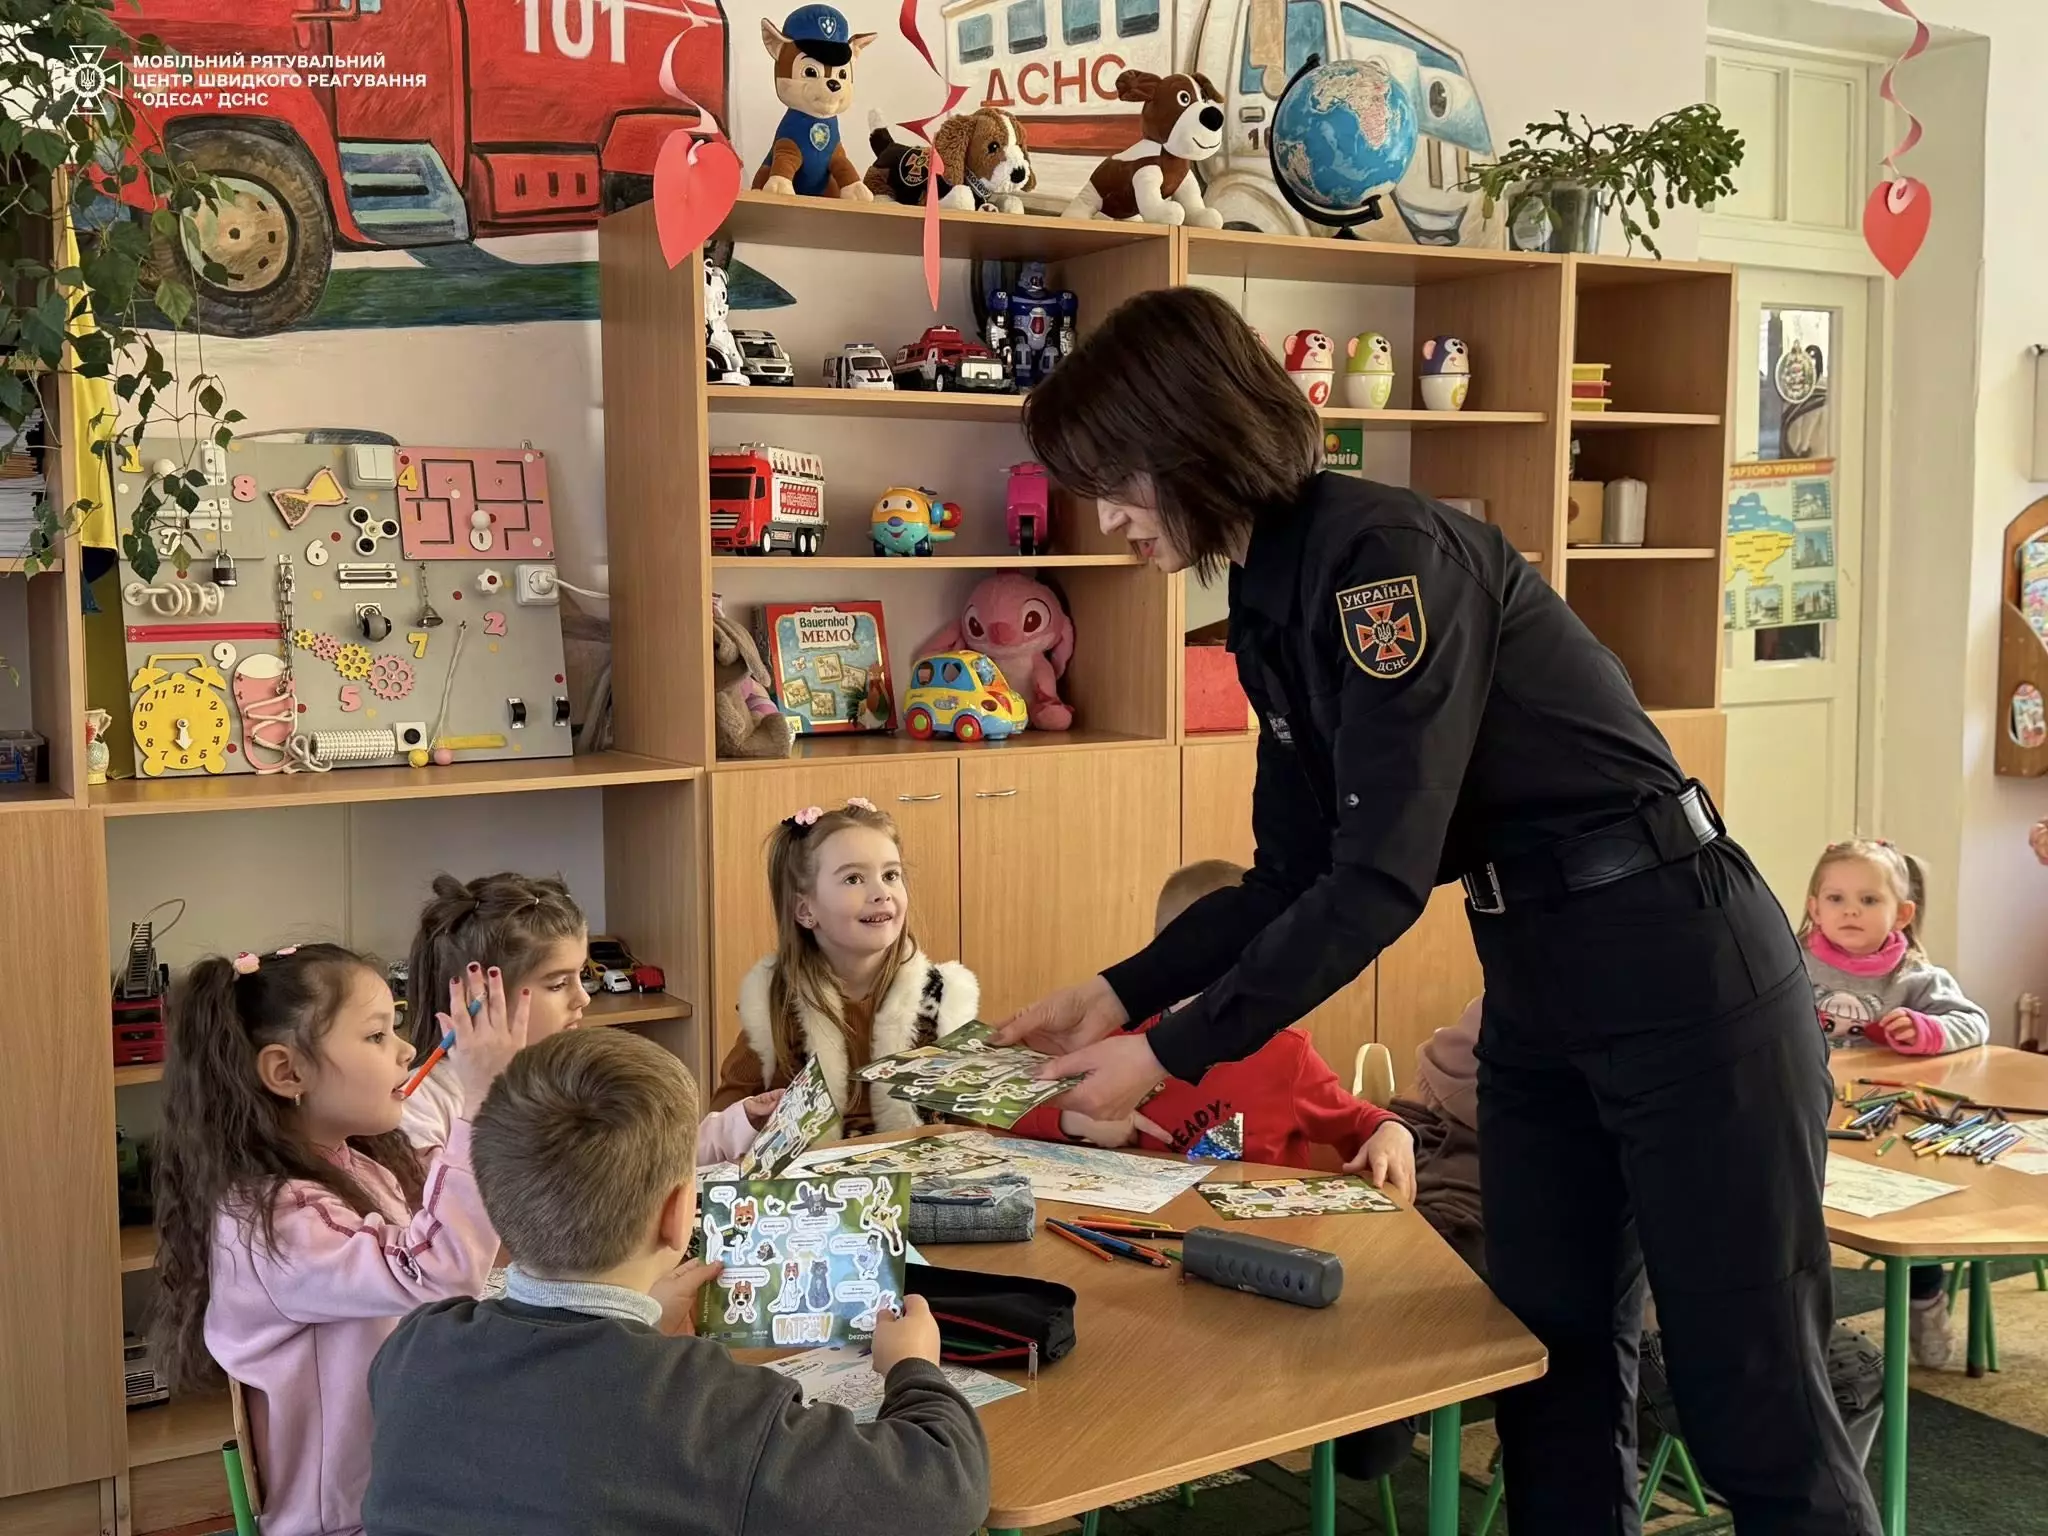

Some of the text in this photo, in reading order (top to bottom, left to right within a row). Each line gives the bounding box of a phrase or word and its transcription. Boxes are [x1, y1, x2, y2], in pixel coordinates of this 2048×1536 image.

[514, 0, 626, 64] 101
[980, 53, 1126, 107] ДСНС
[1314, 383, 1326, 402] 4
[398, 465, 418, 491] 4
[232, 474, 257, 502] 8
[306, 539, 329, 566] 6
[1342, 583, 1412, 608] УКРАЇНА
[484, 611, 508, 637] 2
[799, 615, 849, 628] Bauernhof
[801, 629, 851, 643] MEMO
[407, 632, 428, 658] 7
[213, 642, 237, 670] 9
[1376, 656, 1409, 672] ДСНС
[153, 689, 167, 700] 11
[172, 684, 185, 694] 12
[195, 688, 201, 698] 1
[339, 685, 362, 712] 5
[139, 702, 154, 712] 10
[208, 701, 218, 711] 2
[138, 720, 148, 730] 9
[215, 718, 224, 728] 3
[145, 738, 154, 748] 8
[211, 735, 220, 746] 4
[160, 750, 169, 761] 7
[179, 755, 188, 765] 6
[198, 749, 207, 759] 5
